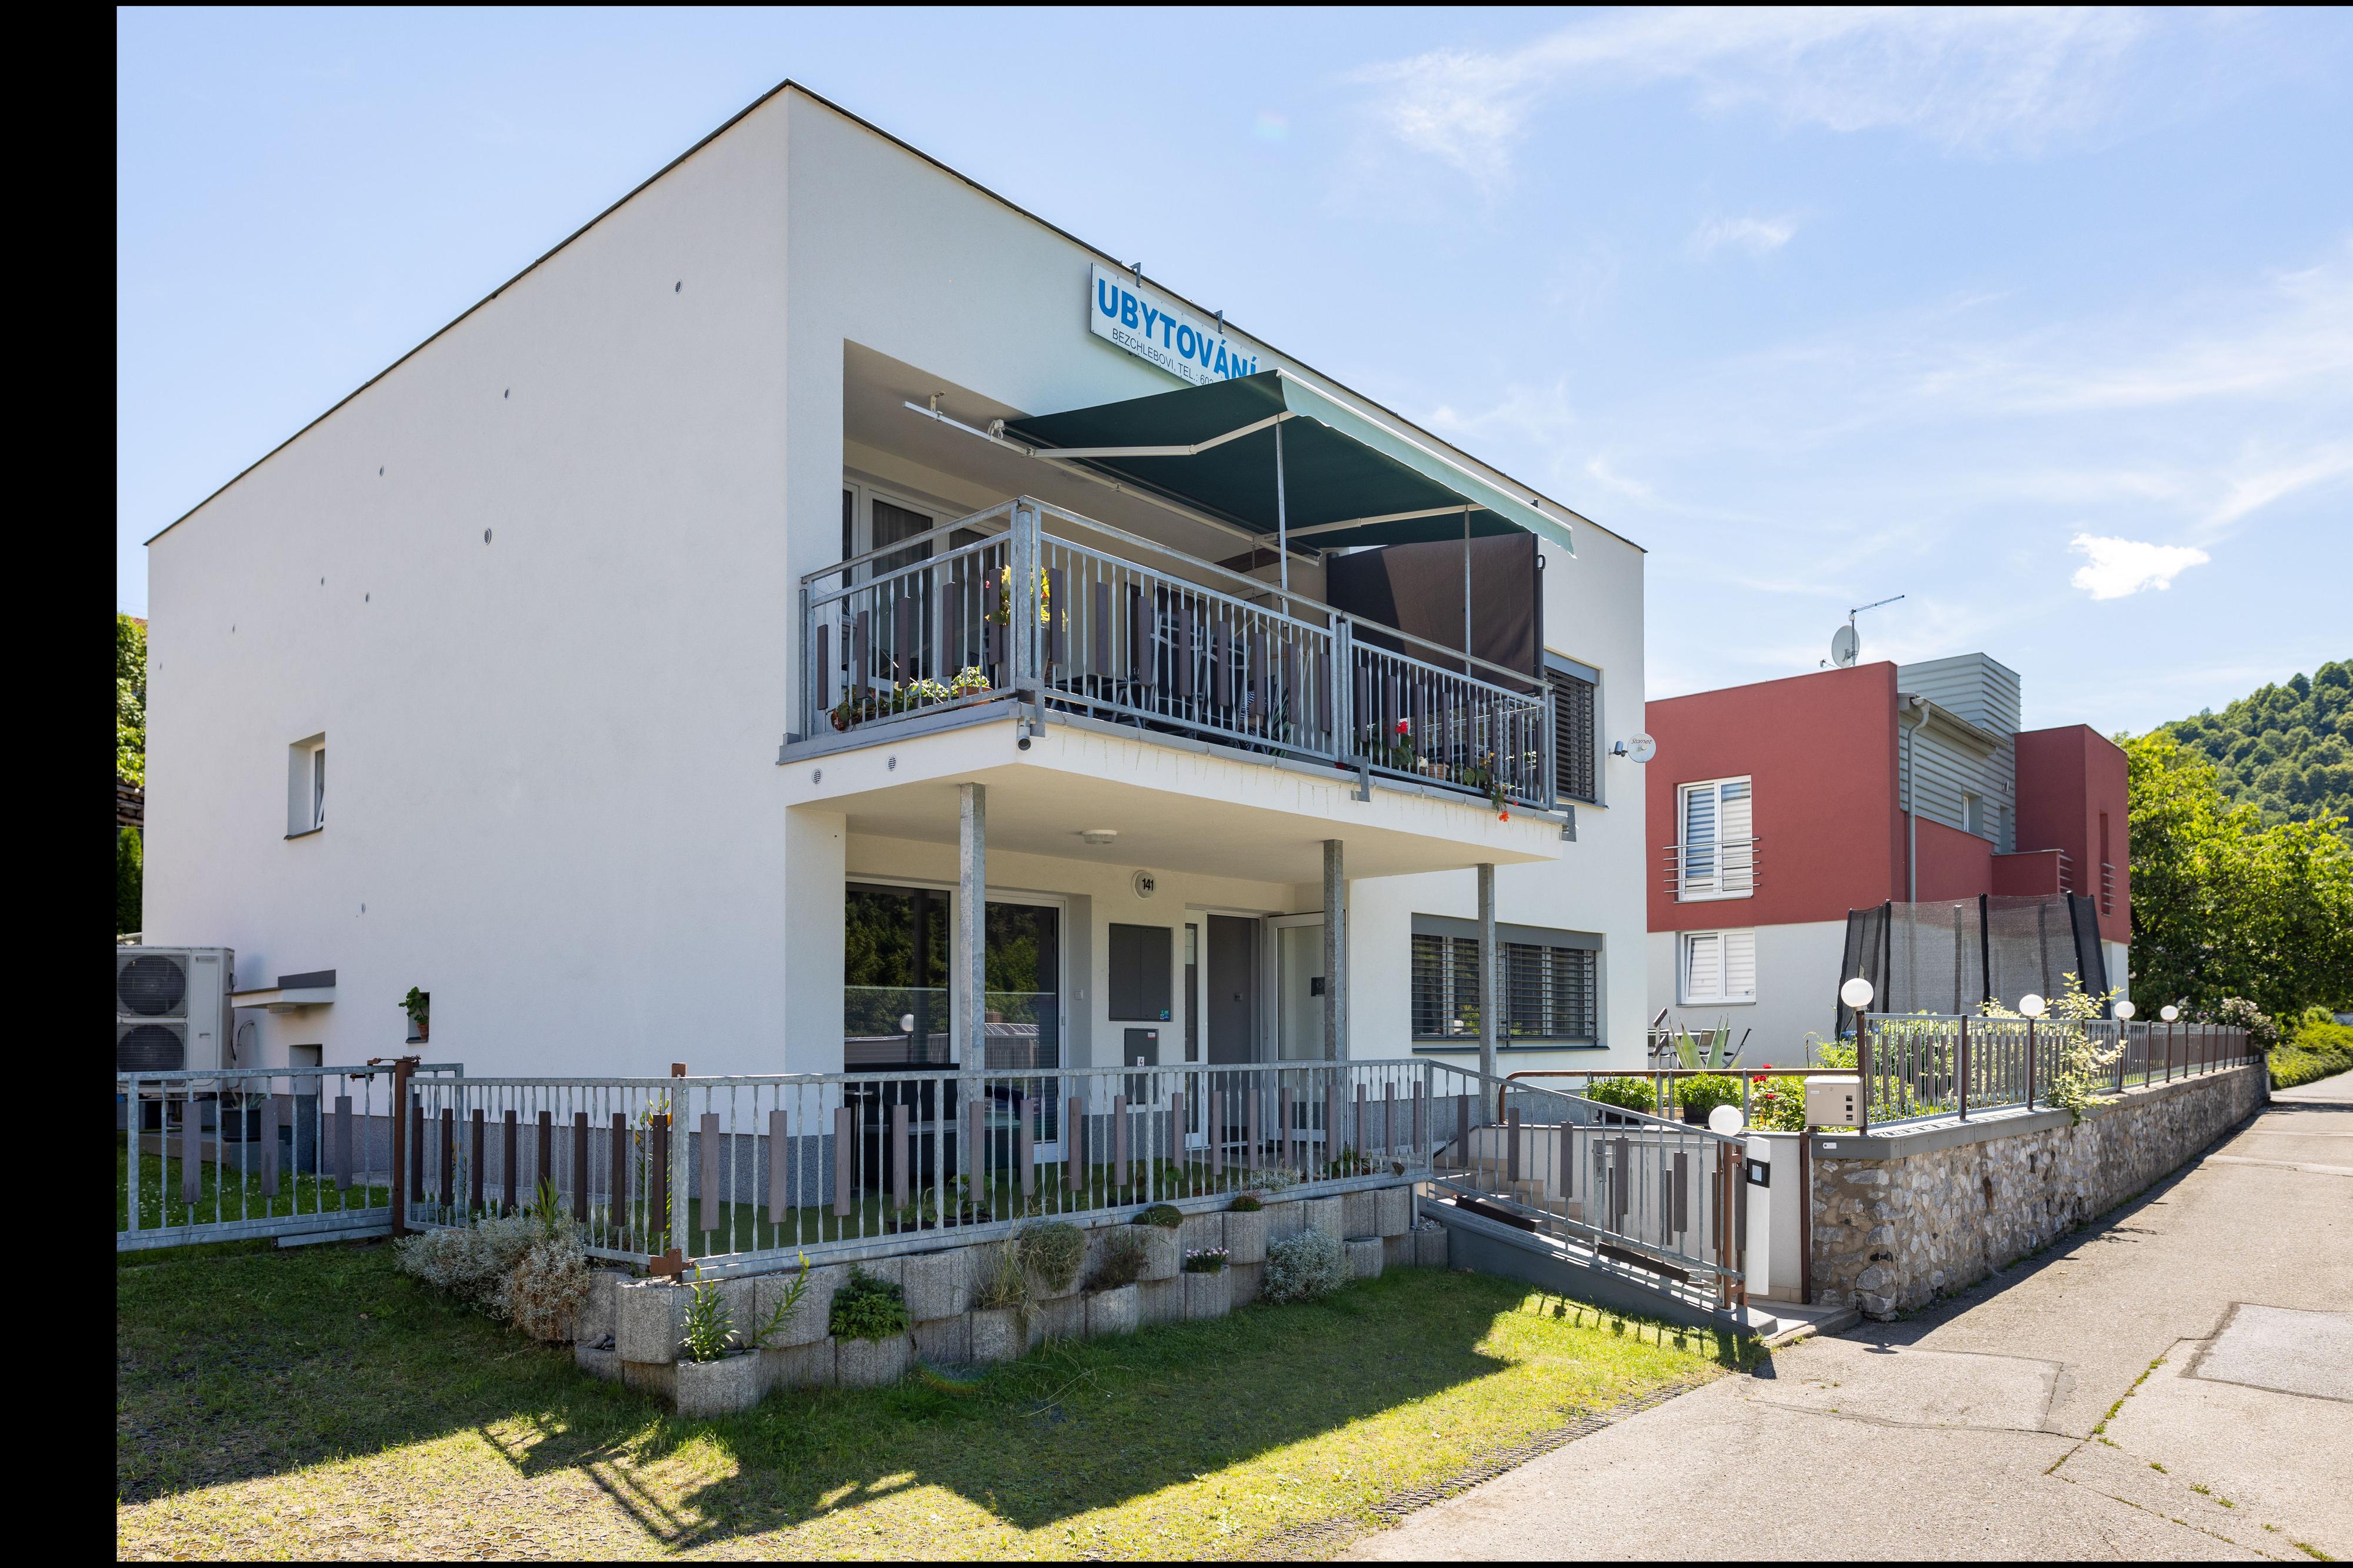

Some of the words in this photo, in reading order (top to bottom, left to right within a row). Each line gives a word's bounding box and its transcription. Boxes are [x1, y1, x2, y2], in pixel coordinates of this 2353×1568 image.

[1112, 328, 1176, 372] BEZCHLEBOVI,
[1178, 362, 1198, 382] TEL.:
[1142, 878, 1154, 891] 141
